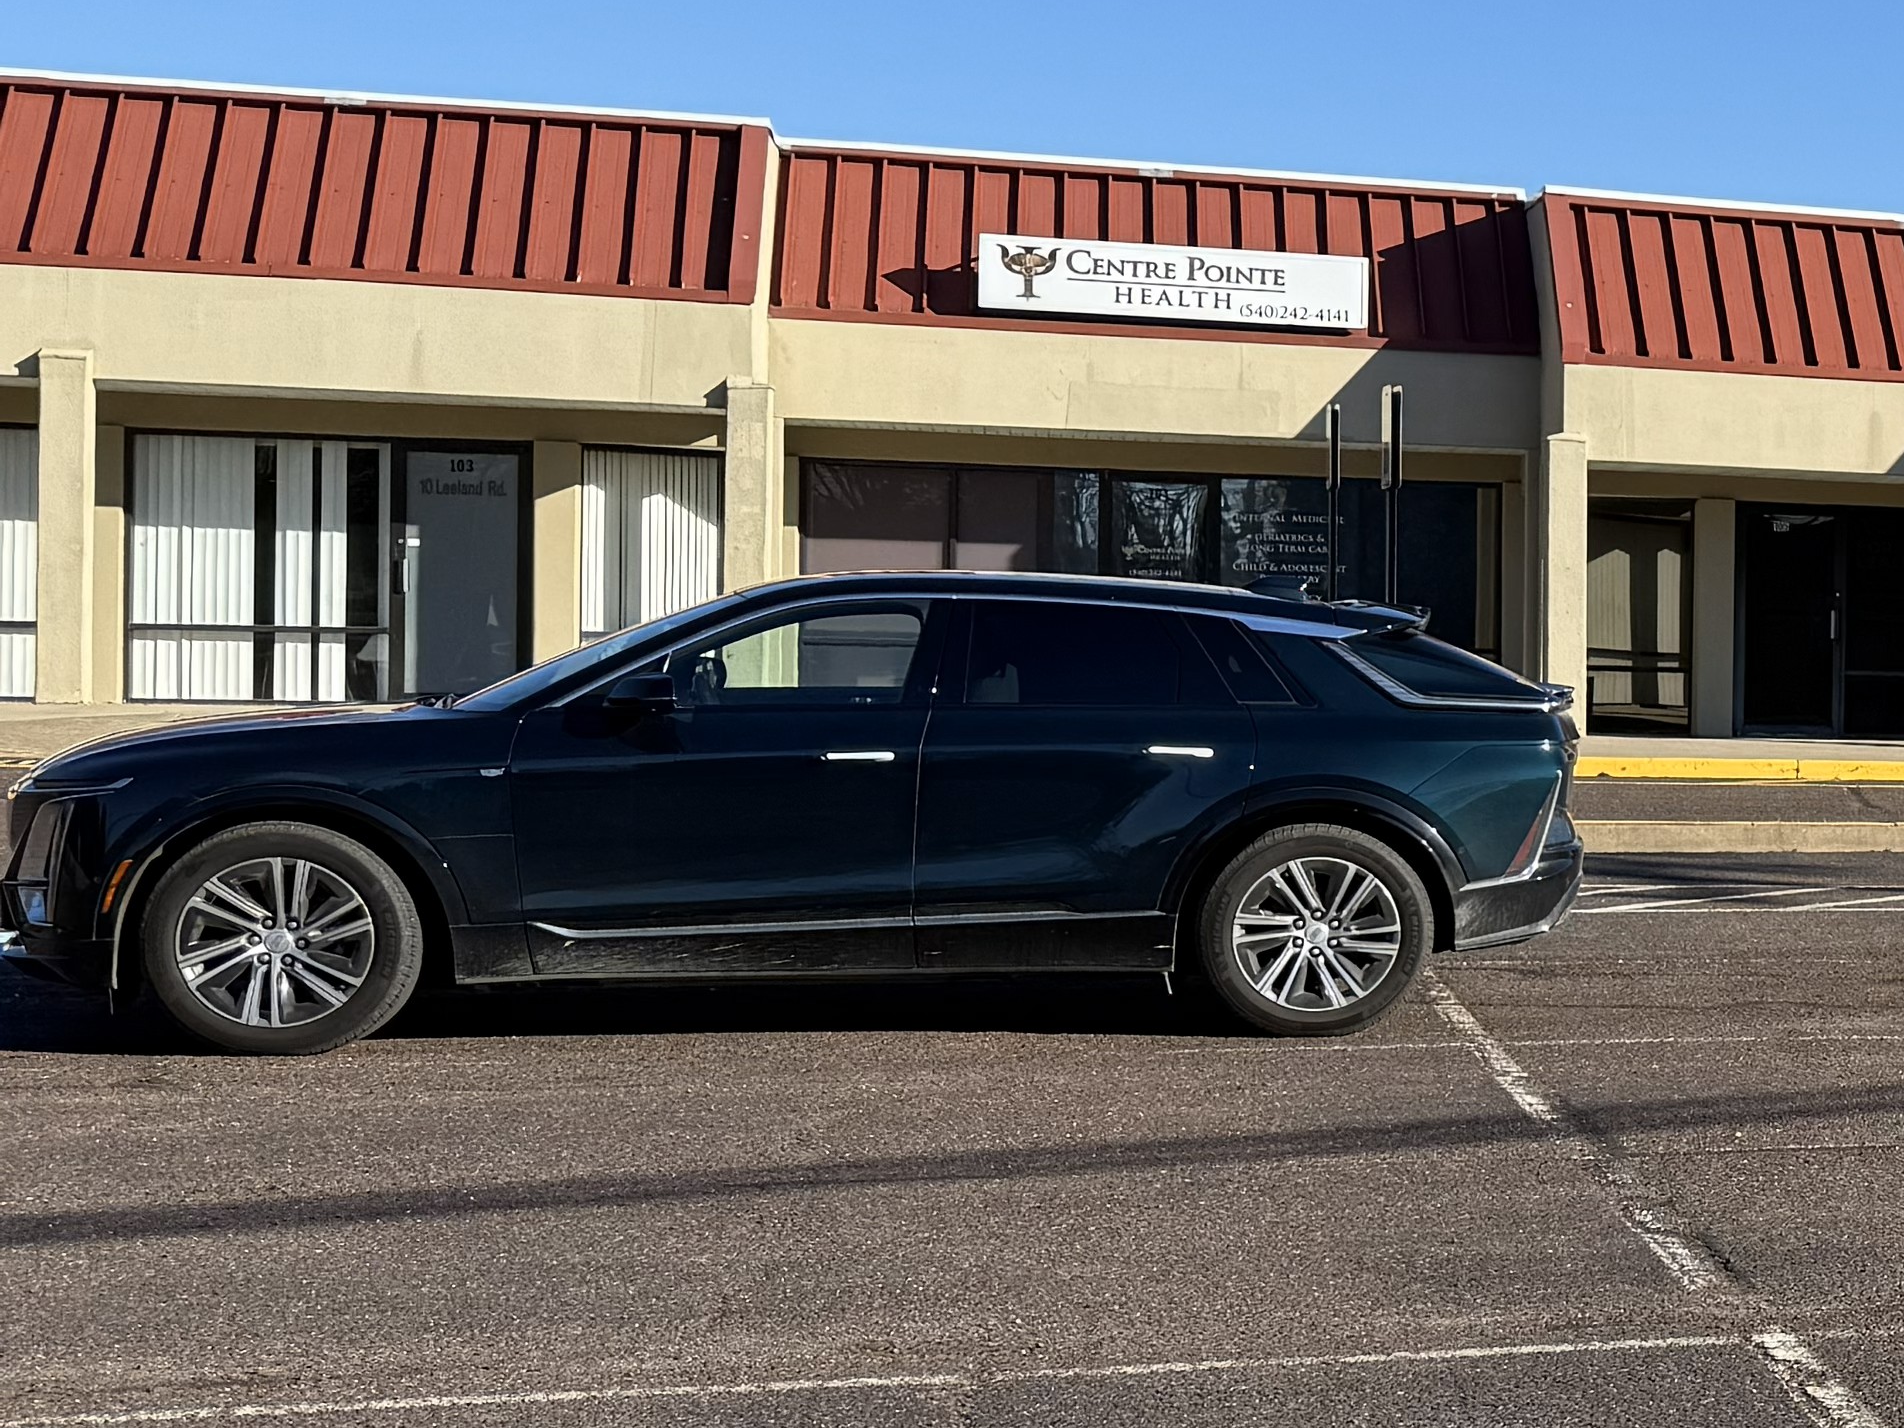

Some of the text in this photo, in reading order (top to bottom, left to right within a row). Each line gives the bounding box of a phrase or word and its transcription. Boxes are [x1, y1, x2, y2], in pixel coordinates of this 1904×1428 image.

[1114, 286, 1232, 310] HEALTH
[1239, 304, 1350, 323] (540)242-4141
[450, 459, 474, 472] 103
